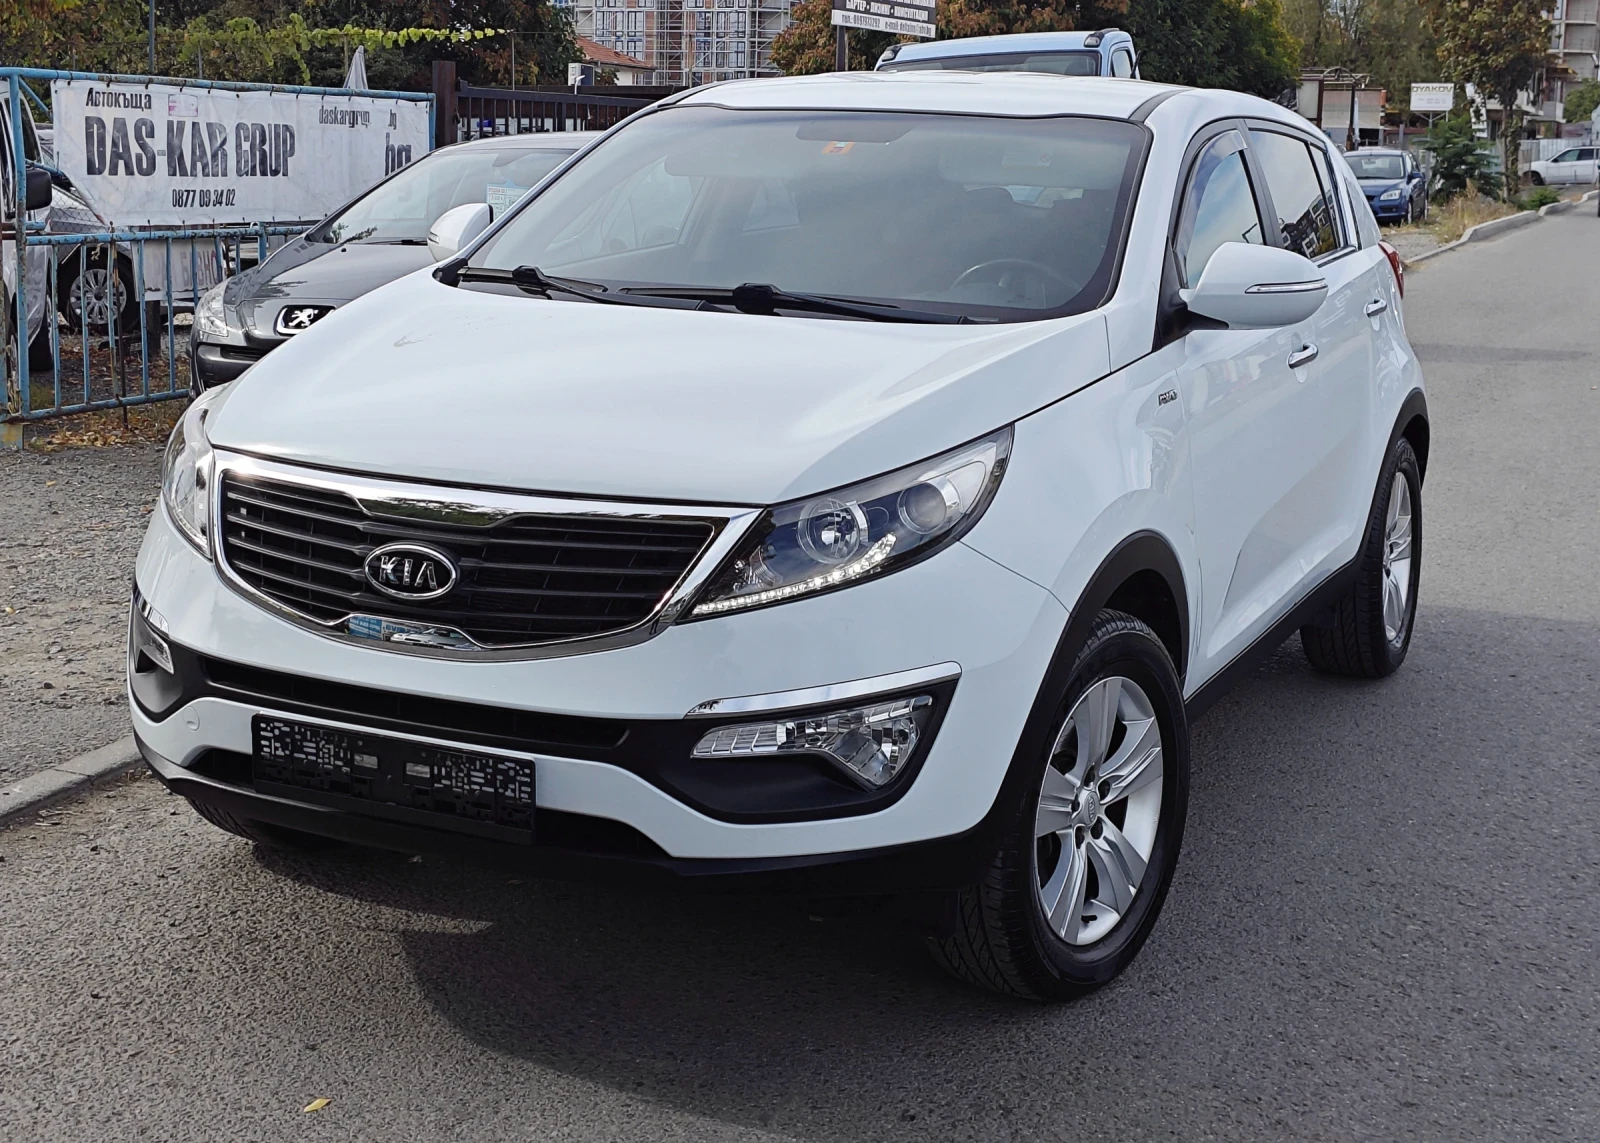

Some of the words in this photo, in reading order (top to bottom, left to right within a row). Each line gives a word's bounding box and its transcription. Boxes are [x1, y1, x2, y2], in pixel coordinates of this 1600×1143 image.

[85, 87, 152, 111] Автокъща
[85, 116, 228, 177] DAS-KAR
[235, 122, 295, 177] GRUP
[172, 188, 196, 208] 0877
[199, 188, 211, 208] 09
[212, 188, 224, 207] 34
[225, 188, 236, 206] 02
[378, 555, 438, 589] KIA
